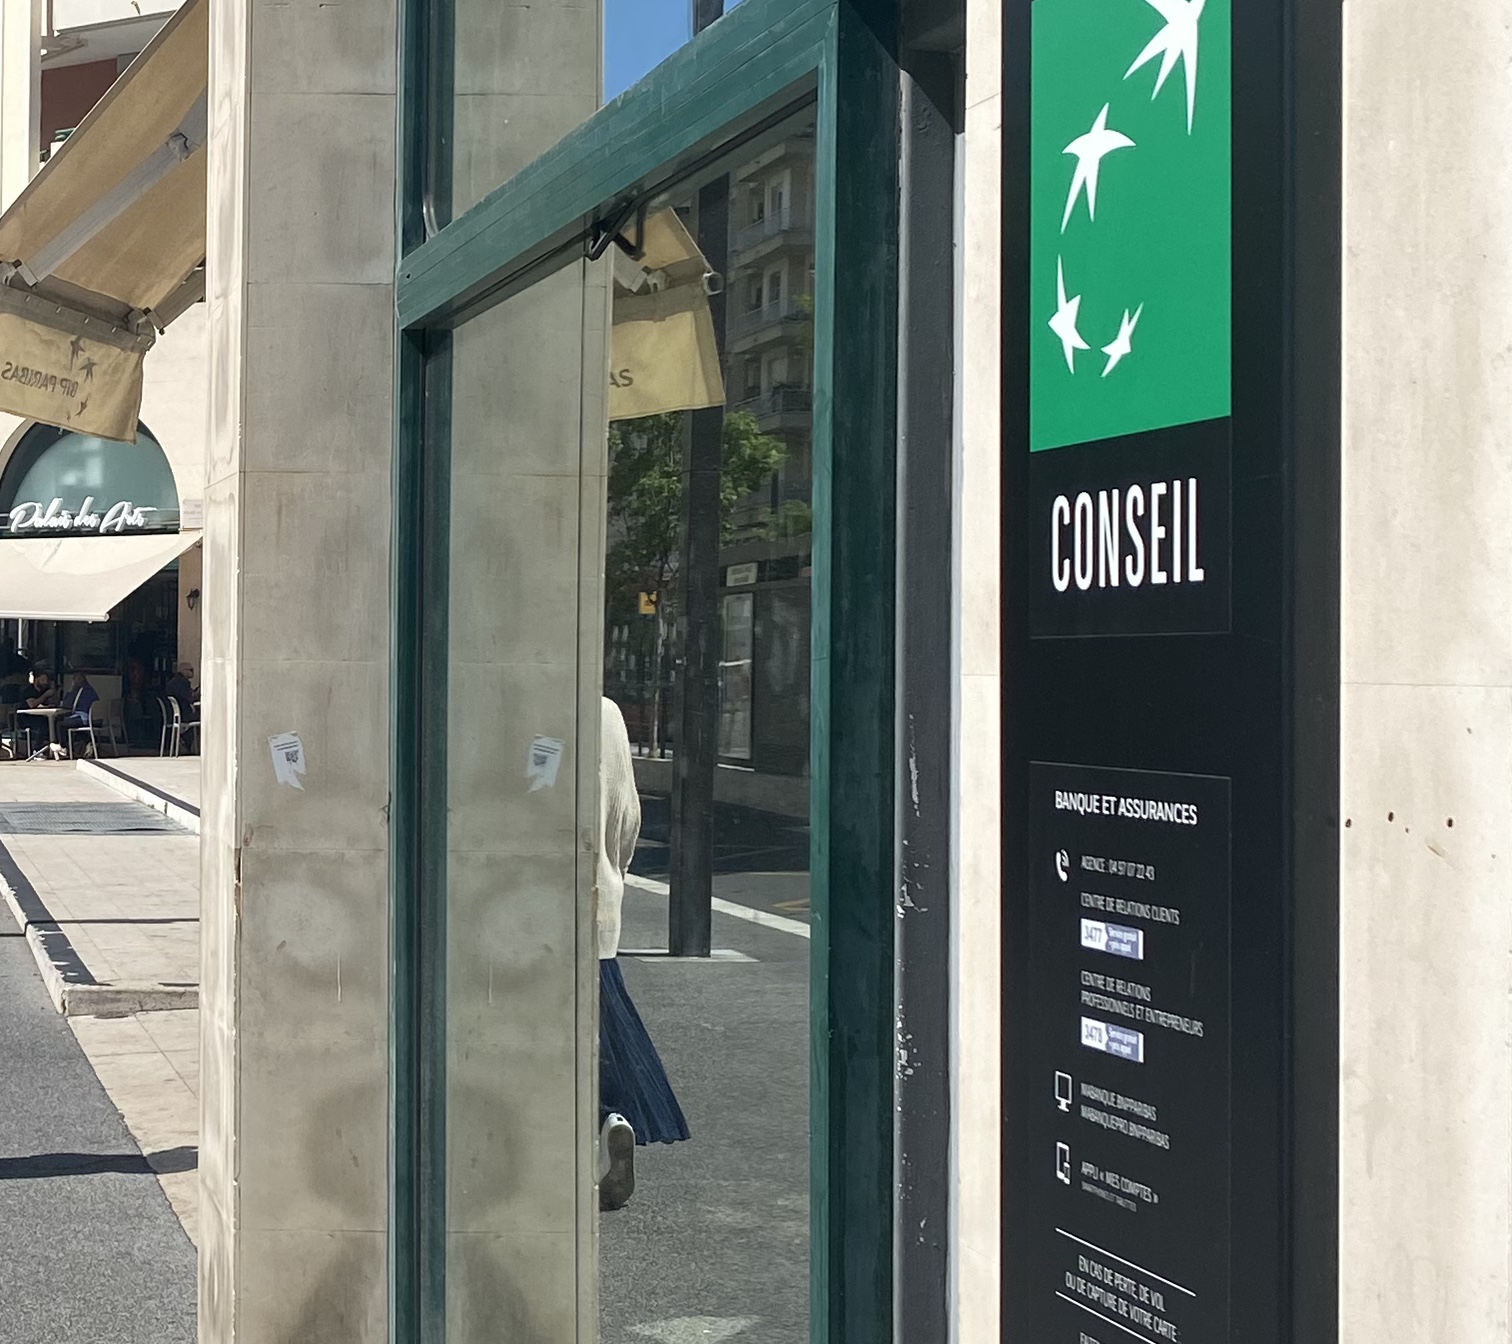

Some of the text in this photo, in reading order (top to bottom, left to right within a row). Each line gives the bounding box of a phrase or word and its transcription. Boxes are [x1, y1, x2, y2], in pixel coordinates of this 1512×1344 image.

[9, 497, 72, 533] Palais
[73, 496, 100, 528] des
[99, 501, 158, 533] Arts
[1052, 477, 1205, 592] CONSEIL
[1055, 790, 1197, 825] BANQUE ET ASSURANCES
[1106, 897, 1114, 912] DE
[1152, 906, 1179, 925] CLIENTS
[1106, 977, 1115, 992] DE
[1121, 1177, 1151, 1202] COMPTES
[1079, 1255, 1088, 1273] EN
[1090, 1261, 1102, 1280] CAS
[1104, 1267, 1113, 1286] DE
[1139, 1284, 1149, 1304] DE
[1150, 1290, 1165, 1312] VOL
[1066, 1272, 1075, 1289] OU
[1077, 1277, 1086, 1295] DE
[1087, 1282, 1117, 1311] CAPTURE
[1118, 1298, 1128, 1317] DE
[1129, 1304, 1152, 1330] VOTRE
[1154, 1316, 1177, 1342] CARTE
